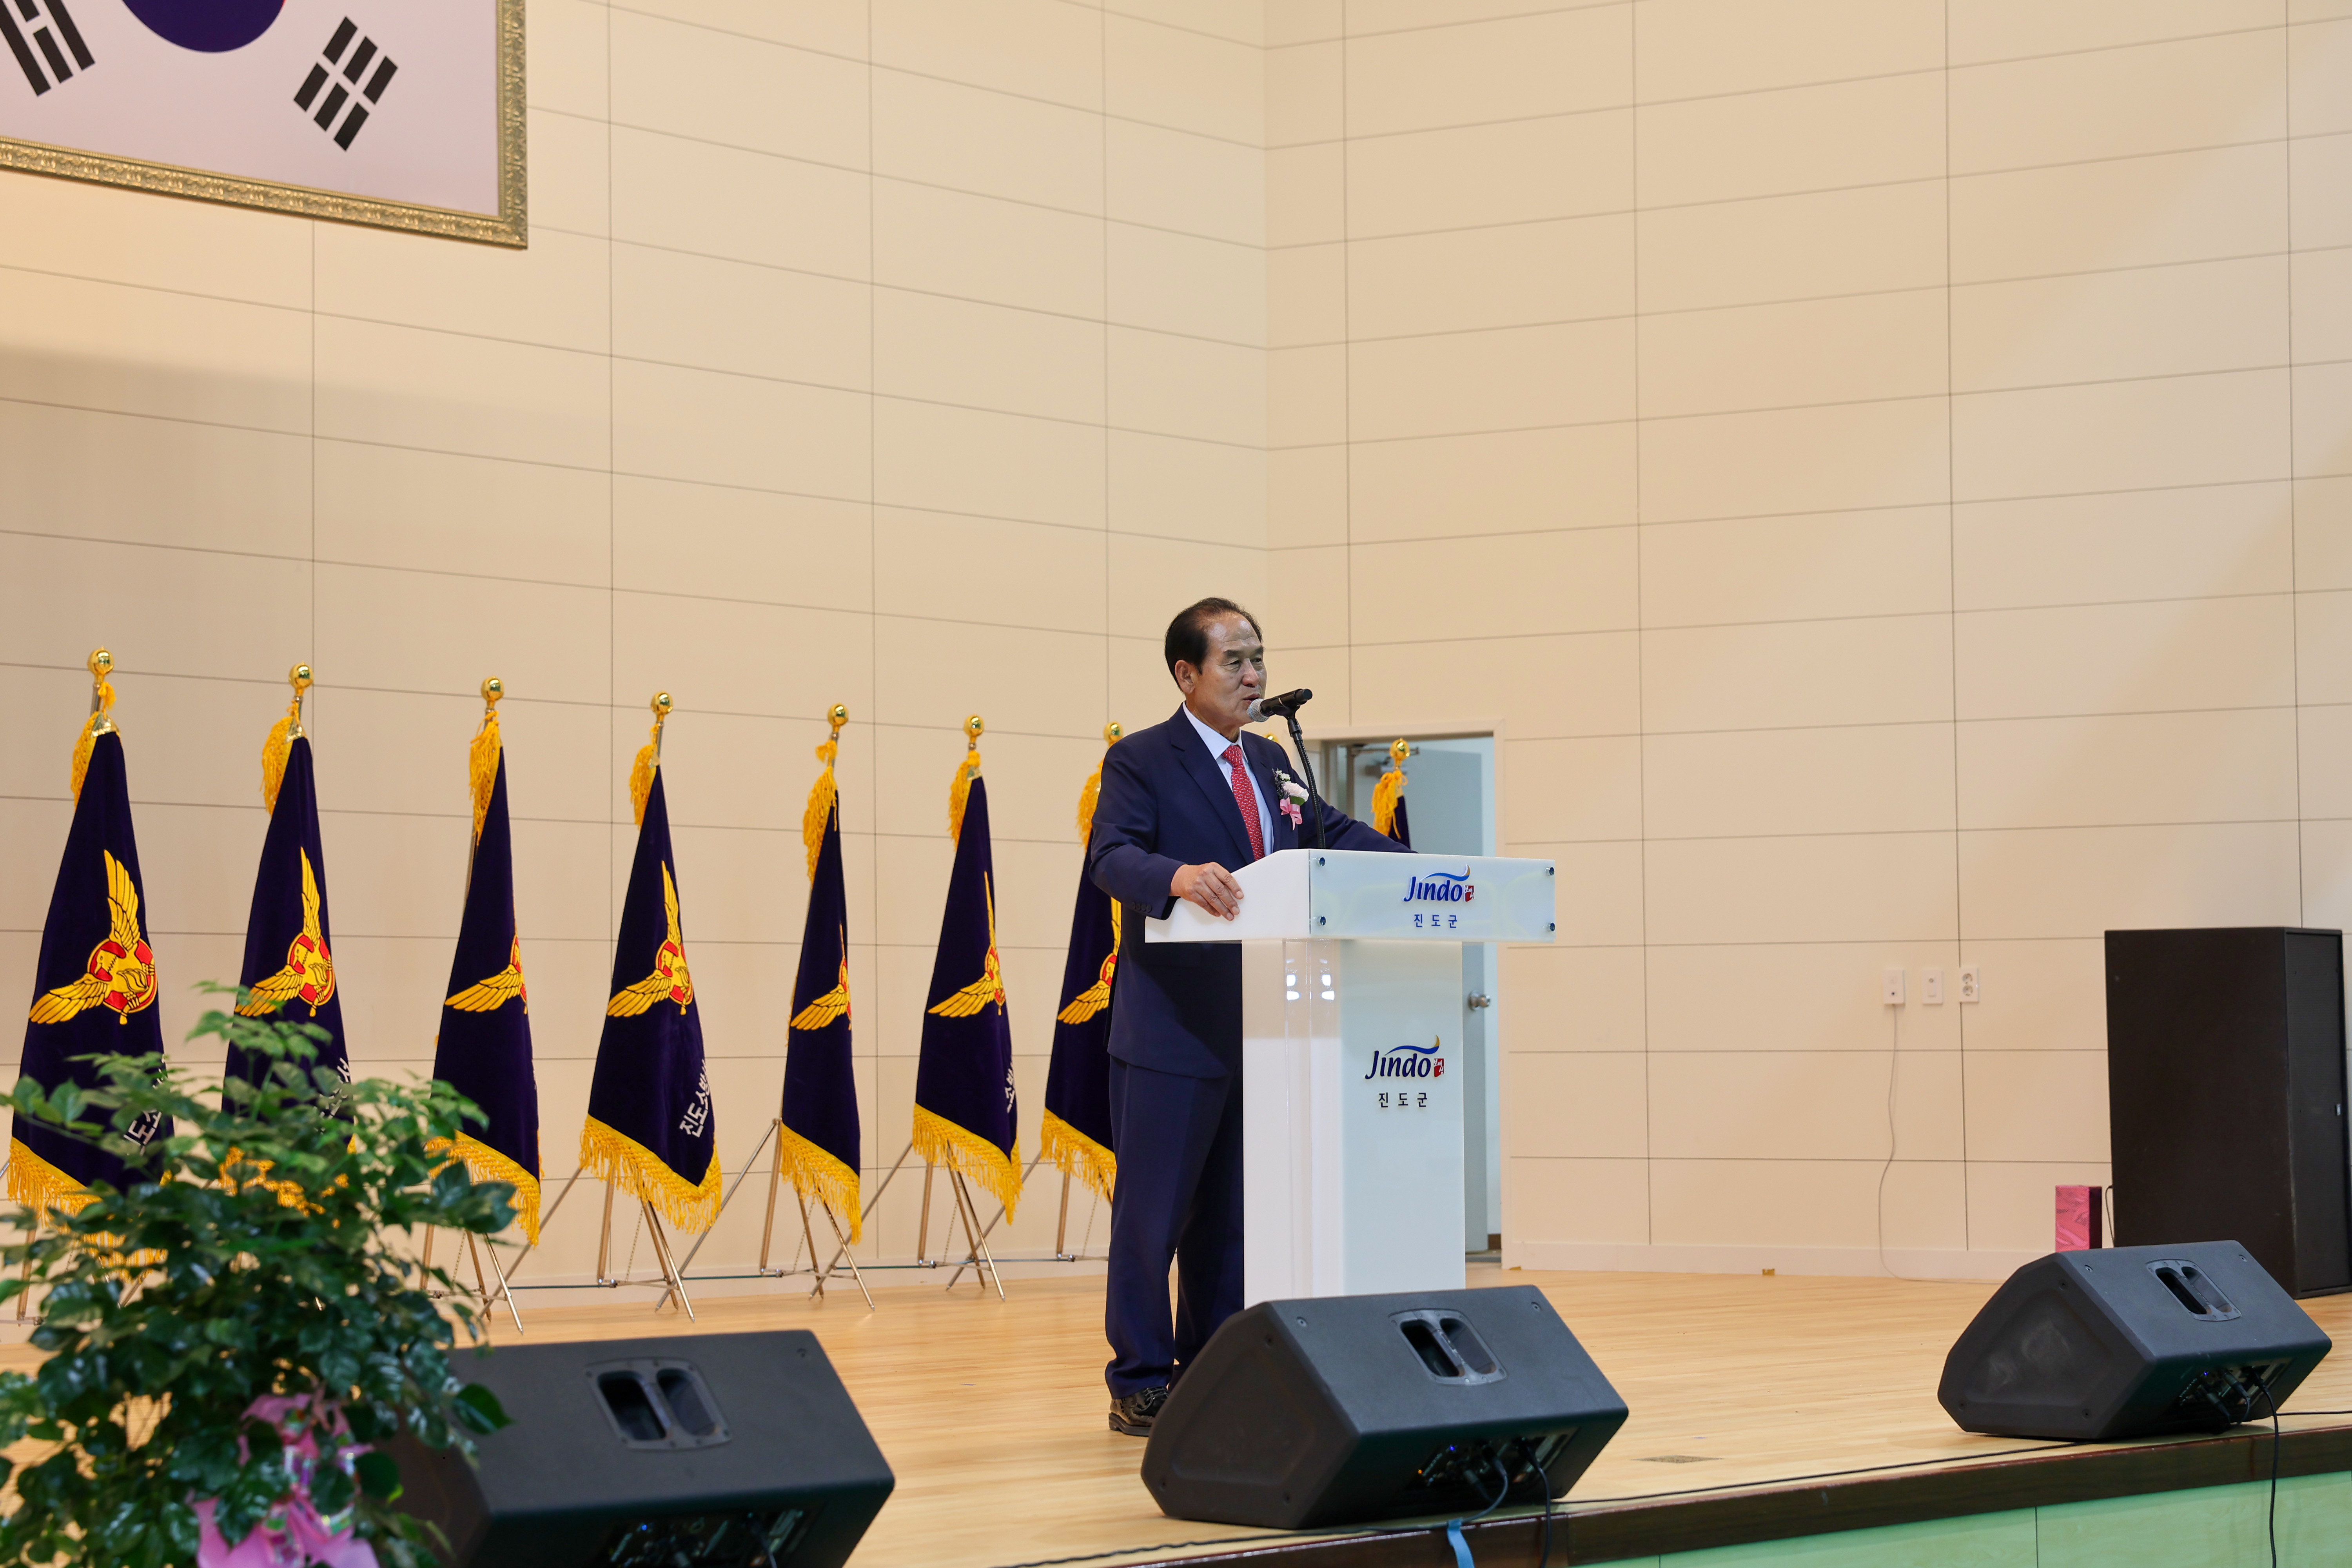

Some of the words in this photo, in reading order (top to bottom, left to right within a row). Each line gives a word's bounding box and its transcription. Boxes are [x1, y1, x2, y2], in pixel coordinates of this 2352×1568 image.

[1402, 876, 1463, 902] Jindo
[1365, 1050, 1431, 1079] Jindo
[679, 1059, 710, 1138] 진도소방
